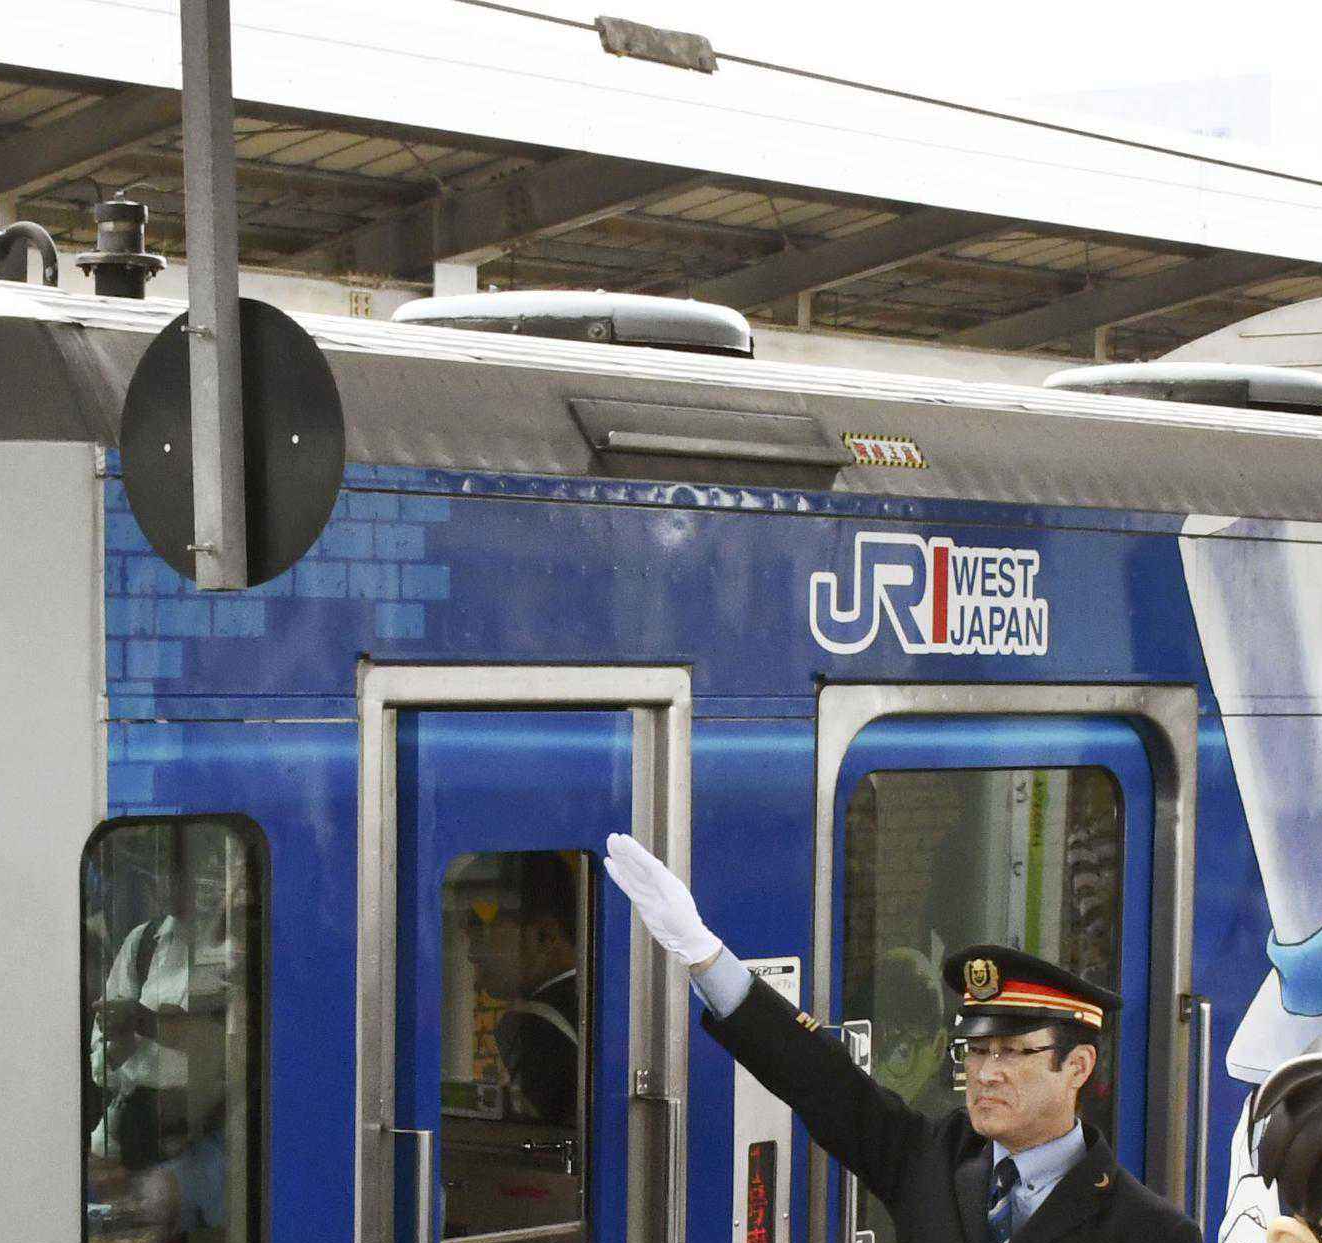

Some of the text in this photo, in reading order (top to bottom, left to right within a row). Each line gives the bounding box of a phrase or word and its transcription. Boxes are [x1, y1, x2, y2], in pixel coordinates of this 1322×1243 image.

[810, 532, 927, 654] JR
[952, 556, 1034, 597] WEST
[949, 605, 1043, 647] JAPAN
